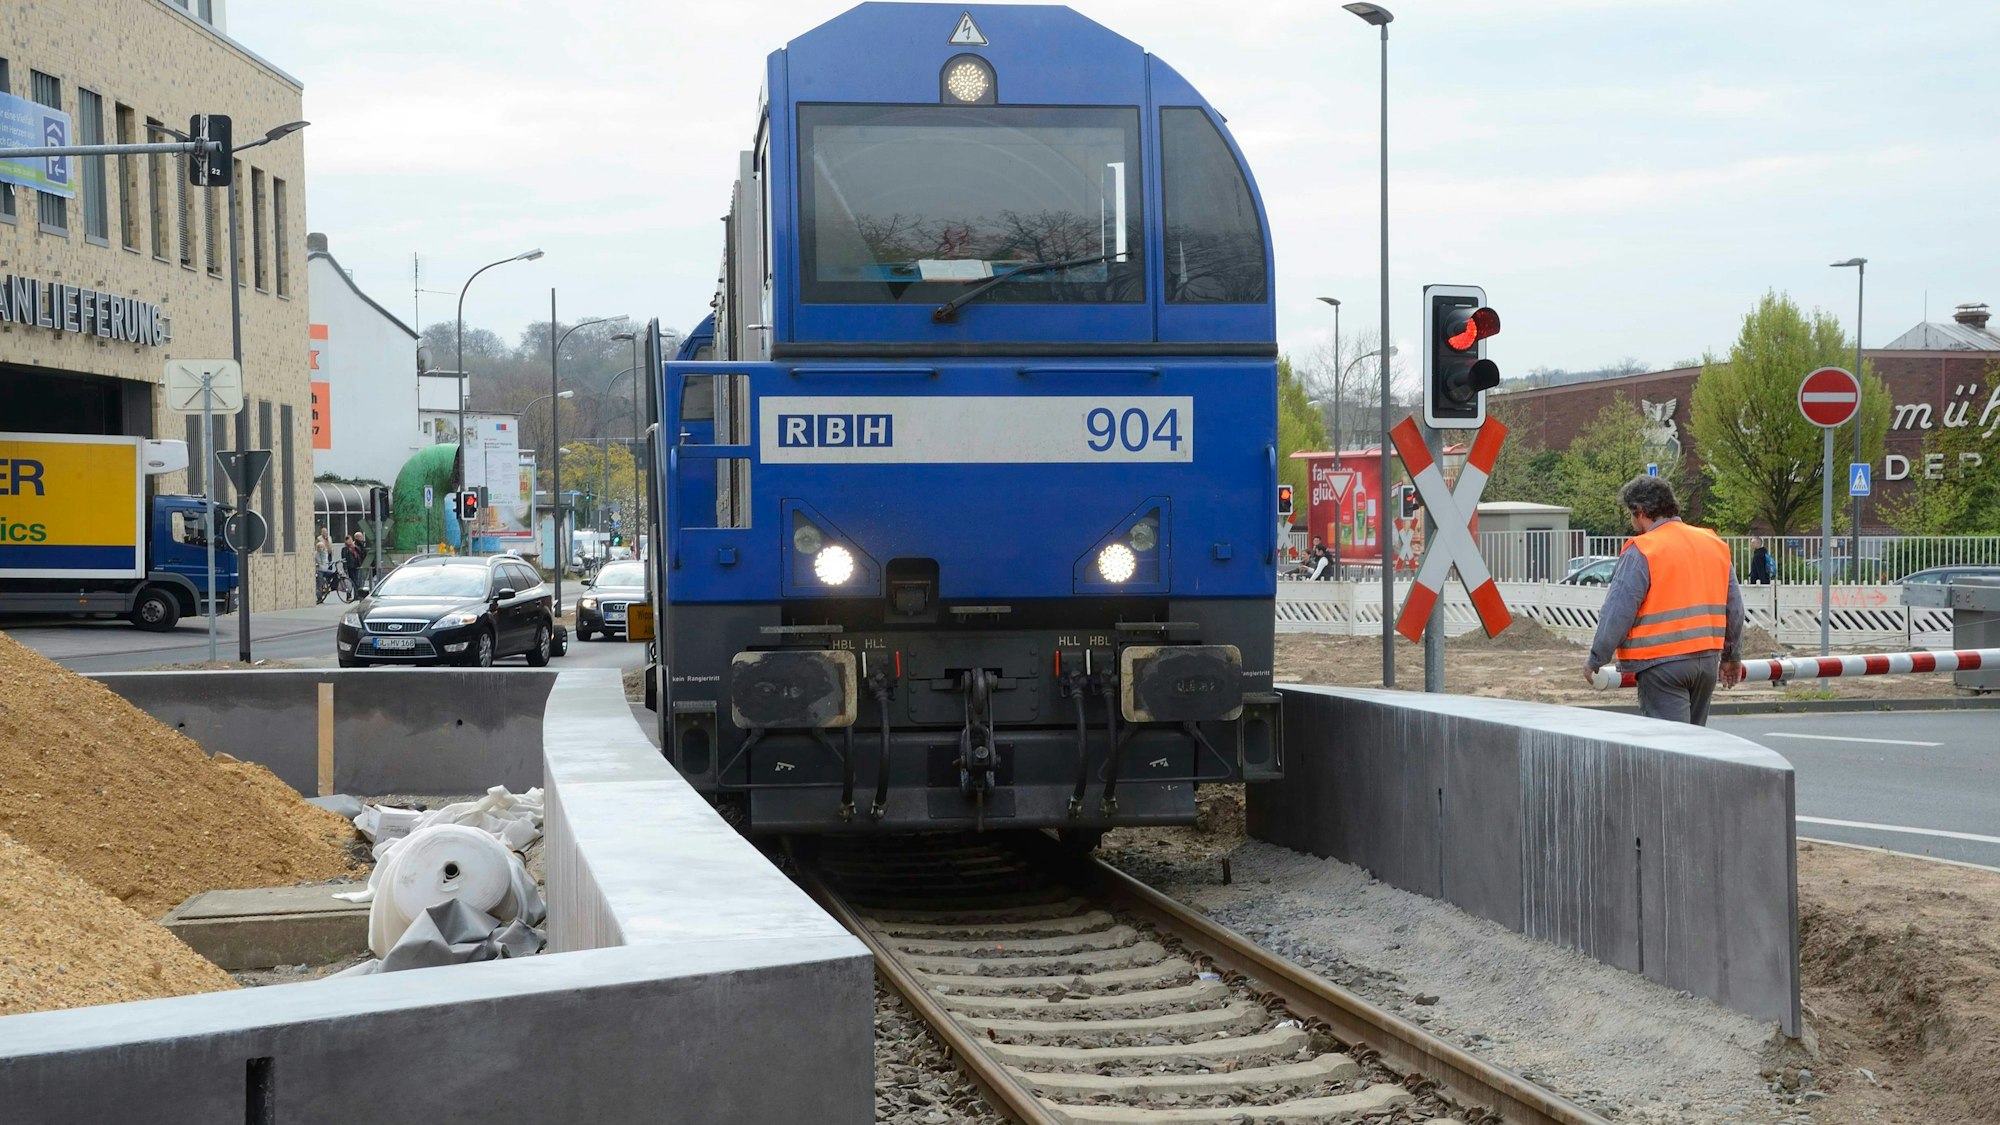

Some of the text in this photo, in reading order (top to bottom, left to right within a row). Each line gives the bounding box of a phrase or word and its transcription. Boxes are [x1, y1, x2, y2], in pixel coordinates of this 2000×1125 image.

[211, 167, 221, 176] 22
[778, 414, 893, 448] RBH
[1086, 408, 1183, 452] 904
[0, 516, 47, 542] ics
[832, 638, 887, 650] HBL HLL
[1058, 635, 1111, 646] HLL HBL
[687, 675, 720, 683] Rangiertritt
[1241, 670, 1270, 678] angiertritt
